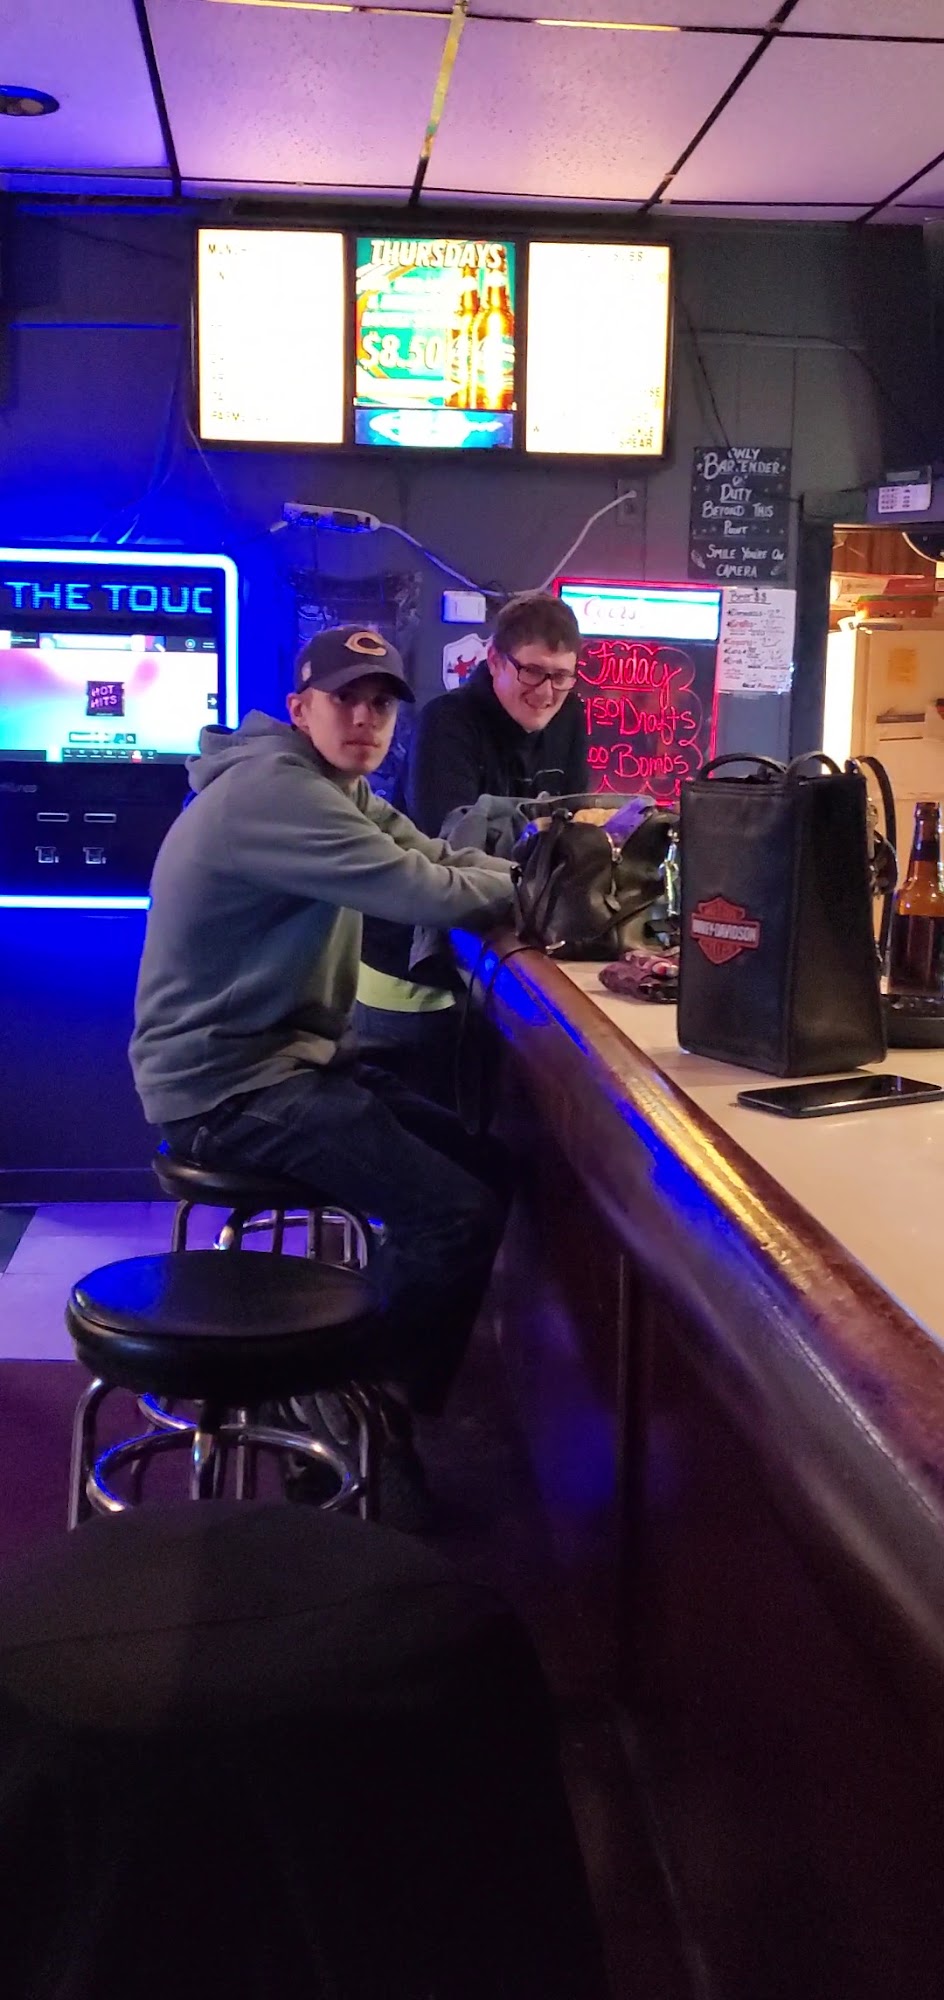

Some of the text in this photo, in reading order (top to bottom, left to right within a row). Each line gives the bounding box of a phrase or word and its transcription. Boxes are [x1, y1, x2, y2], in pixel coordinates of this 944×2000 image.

[370, 239, 505, 269] THURSDAYS
[361, 331, 441, 370] $8.50
[720, 483, 752, 502] DUTY
[702, 500, 774, 518] BEYOND THIS
[724, 520, 749, 534] POINT
[706, 544, 736, 560] SMILE
[716, 564, 758, 578] CAMERA
[3, 581, 213, 614] THE TOUC
[345, 631, 387, 657] C
[578, 642, 682, 711] Friday
[90, 695, 118, 708] HITS
[91, 684, 115, 697] HOT
[620, 696, 696, 745] Drafts
[611, 743, 689, 778] Bombs
